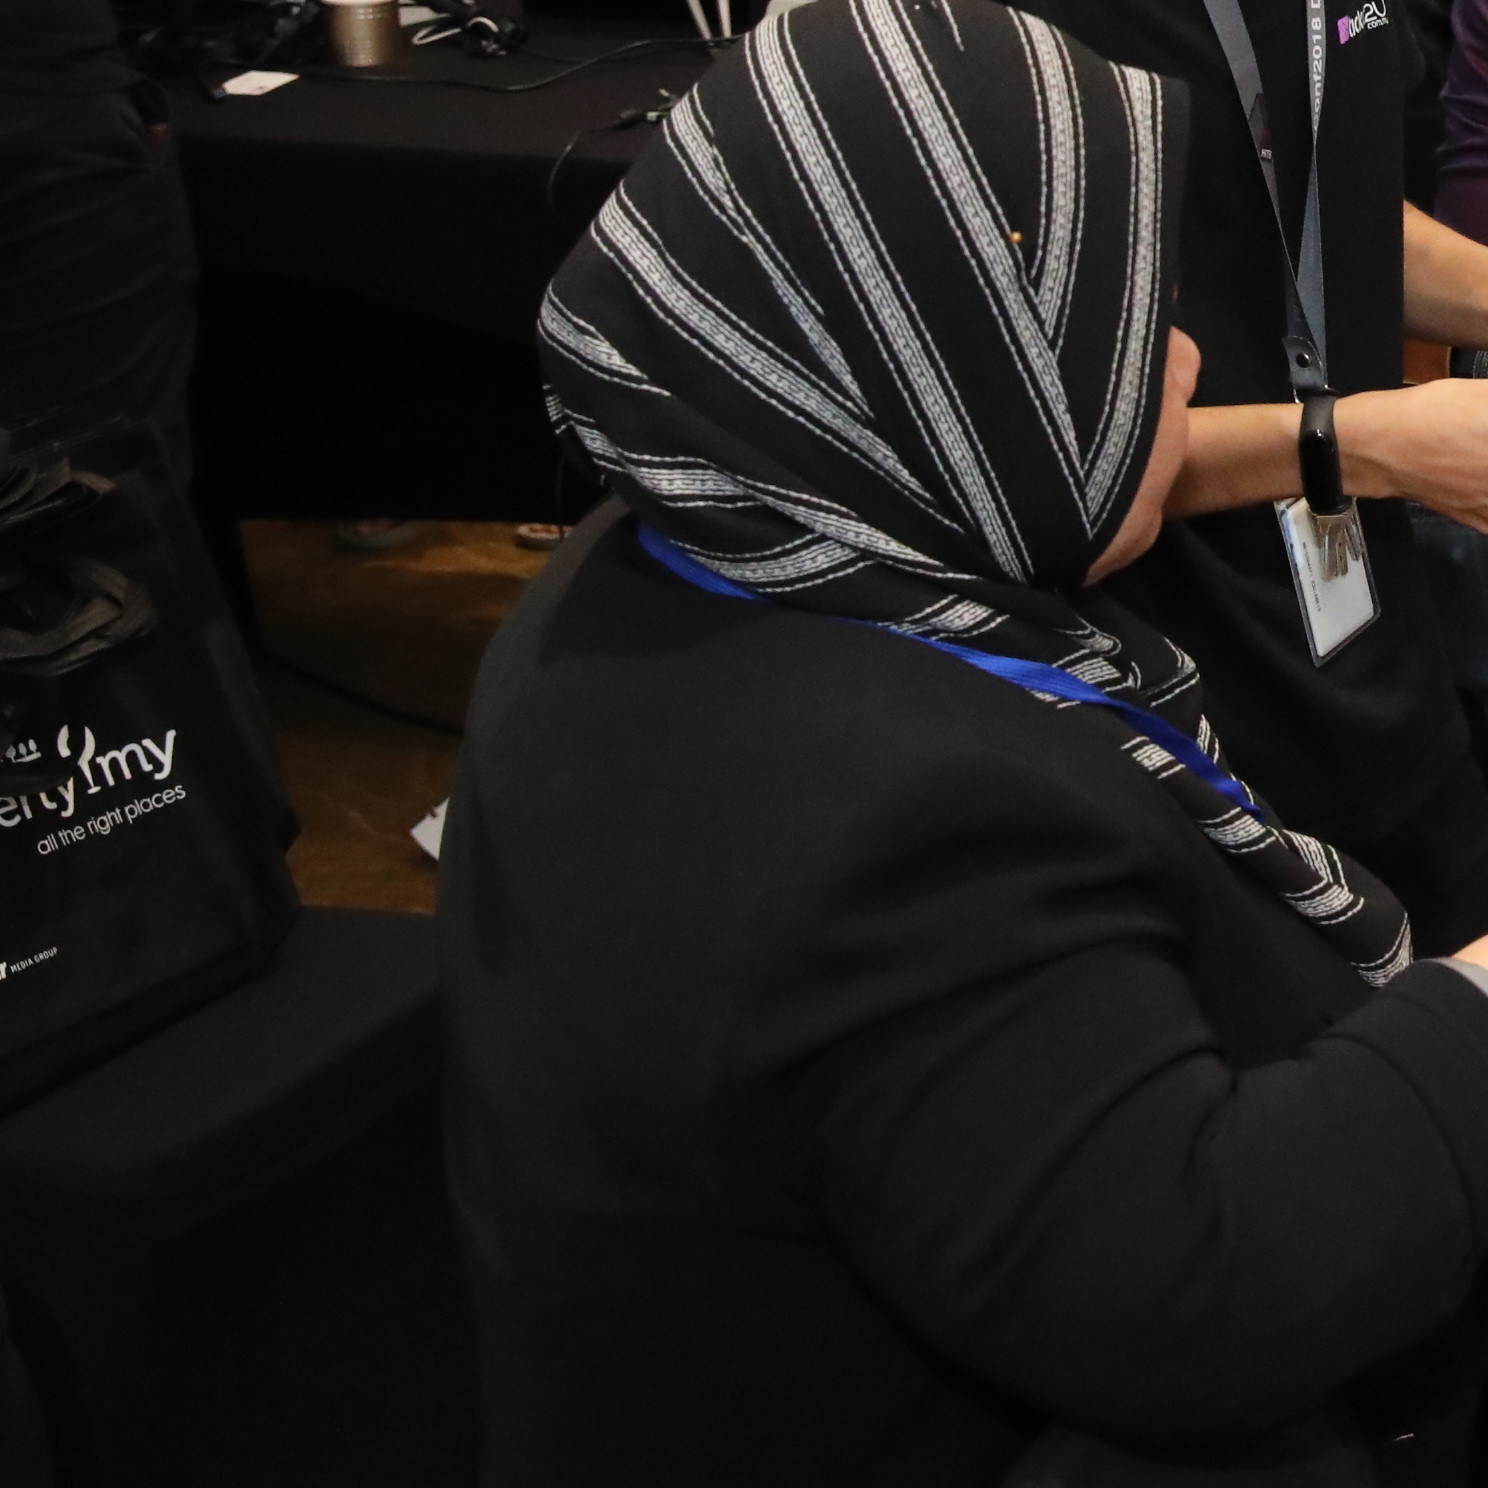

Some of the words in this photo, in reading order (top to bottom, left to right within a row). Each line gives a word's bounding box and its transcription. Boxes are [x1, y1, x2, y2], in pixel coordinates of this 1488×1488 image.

[37, 832, 60, 855] all
[57, 825, 87, 847] the
[87, 808, 124, 835] right
[124, 784, 187, 825] places
[10, 957, 35, 973] MEDIA
[33, 946, 58, 963] GROUP
